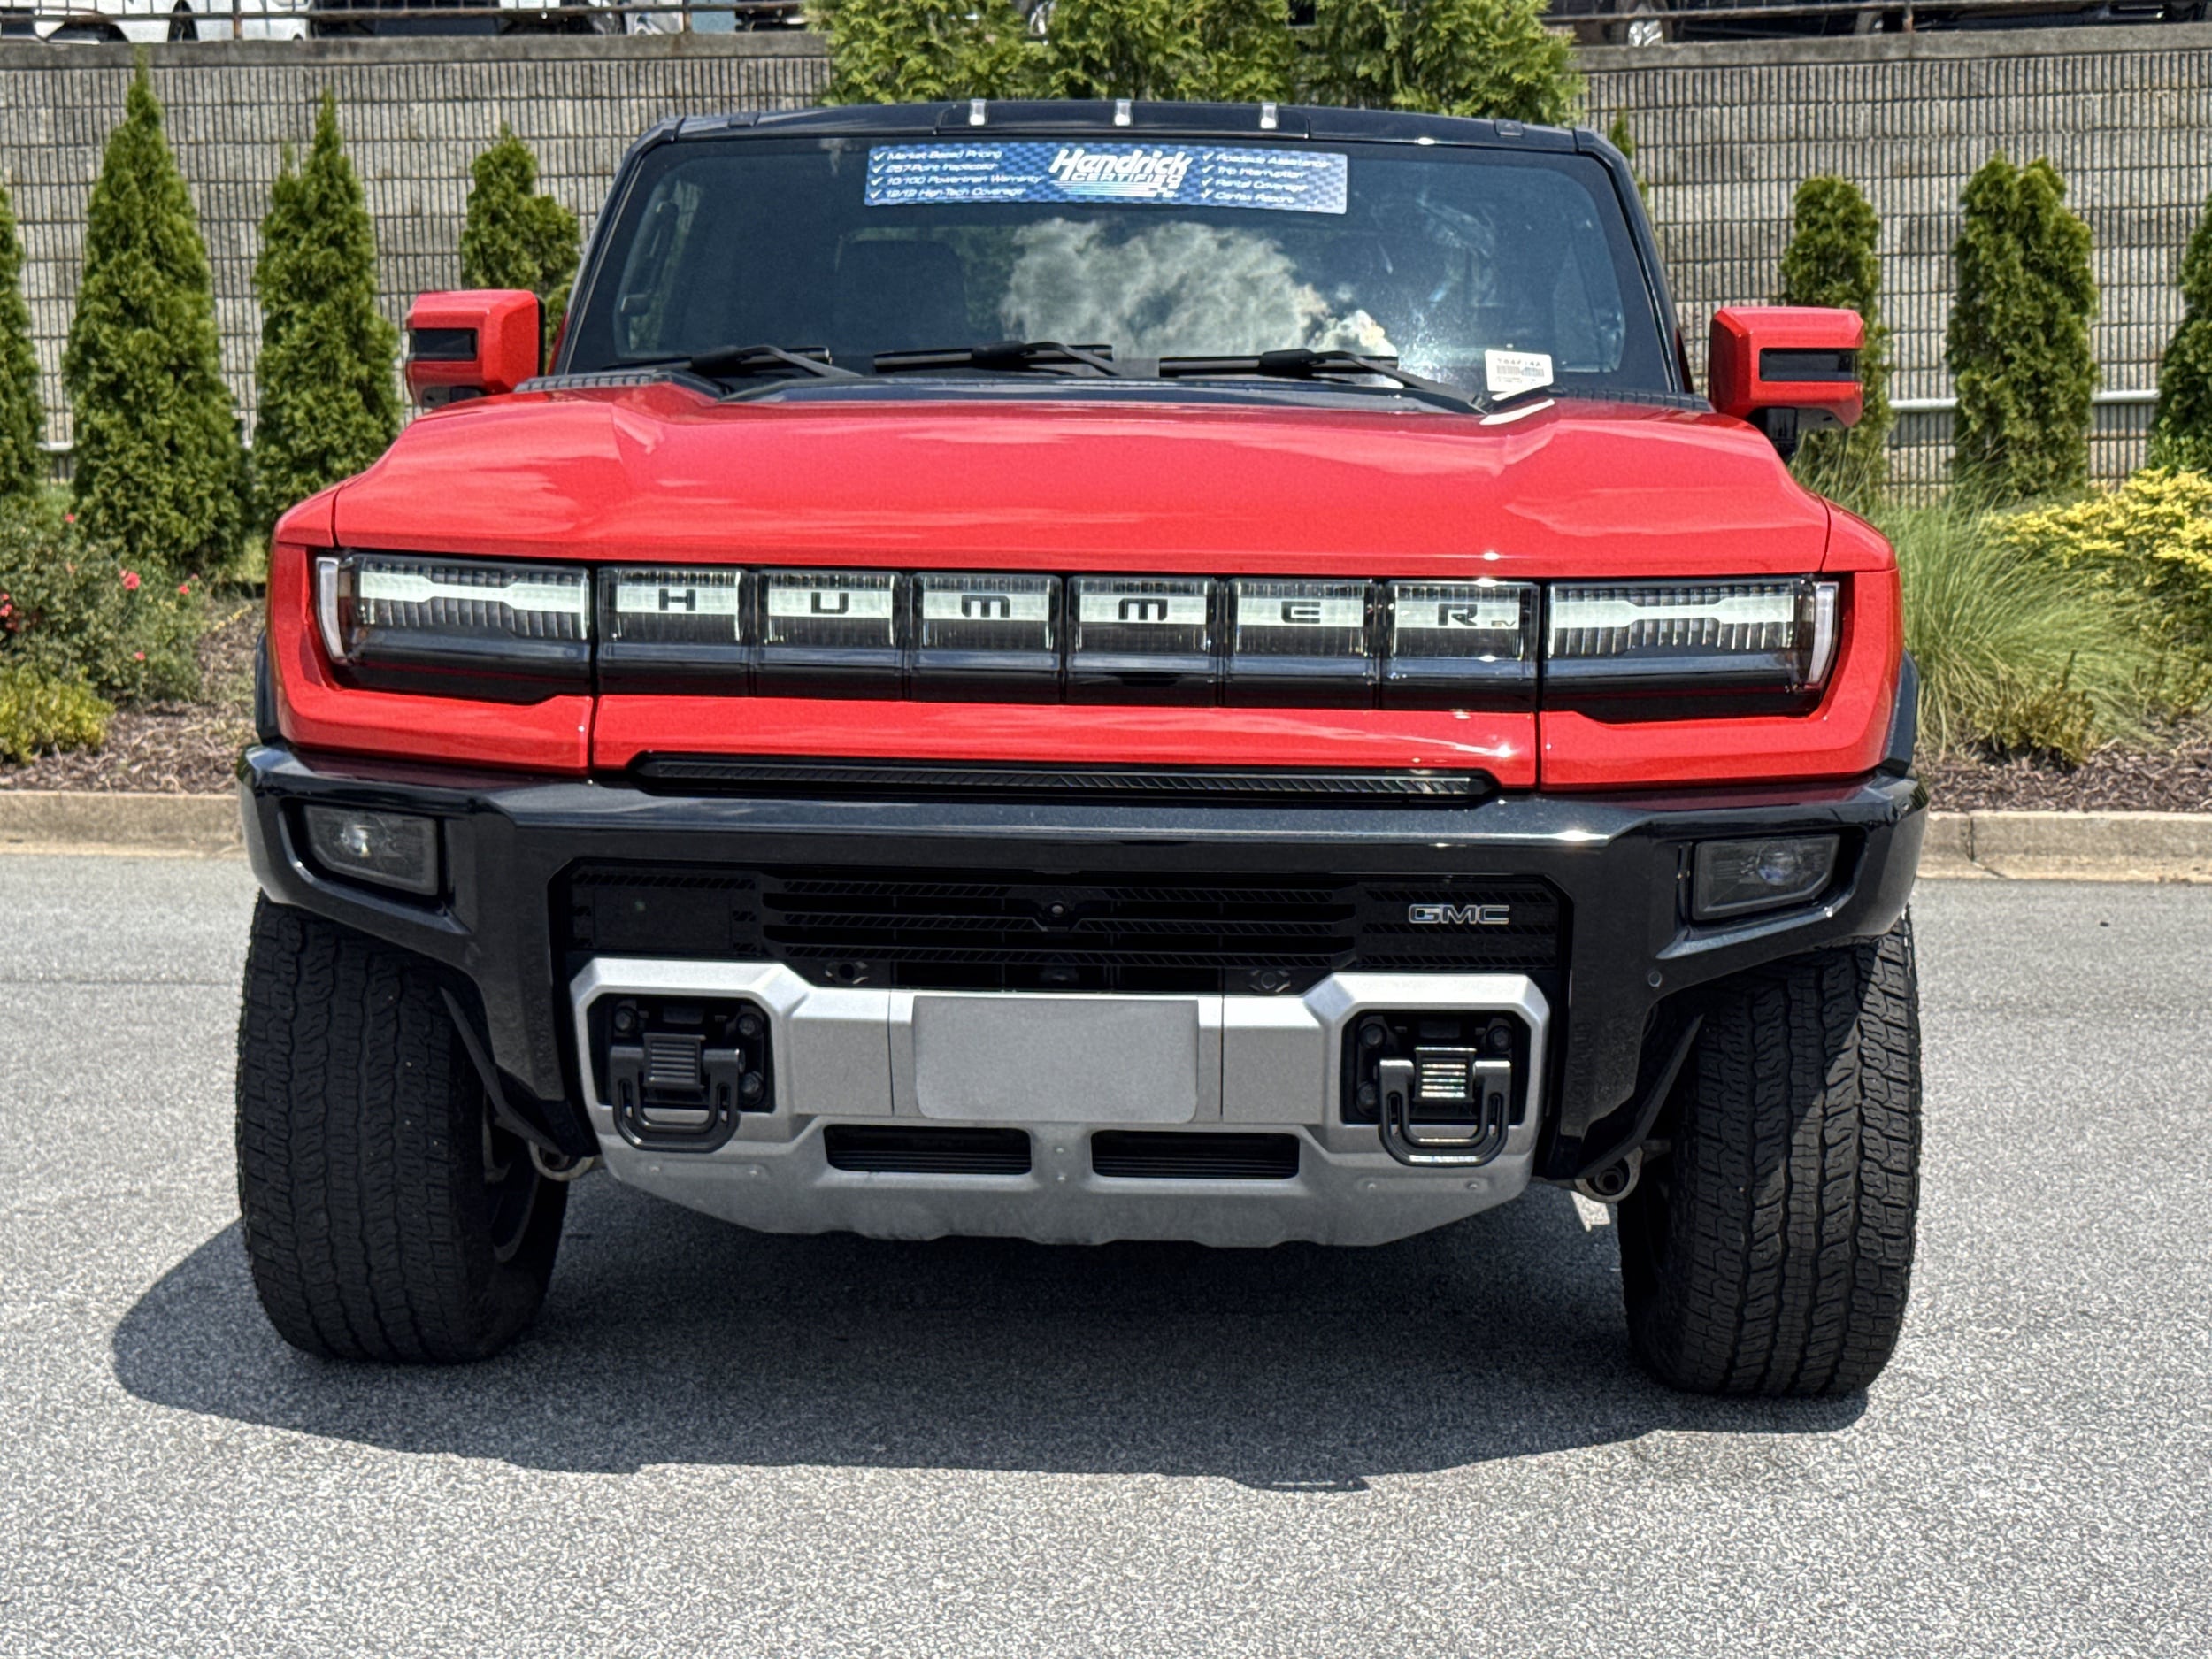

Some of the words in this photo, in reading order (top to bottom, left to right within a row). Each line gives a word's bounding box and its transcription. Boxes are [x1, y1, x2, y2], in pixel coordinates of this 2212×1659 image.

[1048, 148, 1194, 181] Hendrick
[1217, 166, 1238, 176] Trip
[887, 176, 926, 186] 10/100
[927, 175, 988, 184] Powertrain
[990, 173, 1044, 184] Warranty
[886, 188, 918, 198] 12/12
[657, 588, 1479, 627] HUMMER
[1408, 903, 1510, 925] GMC
